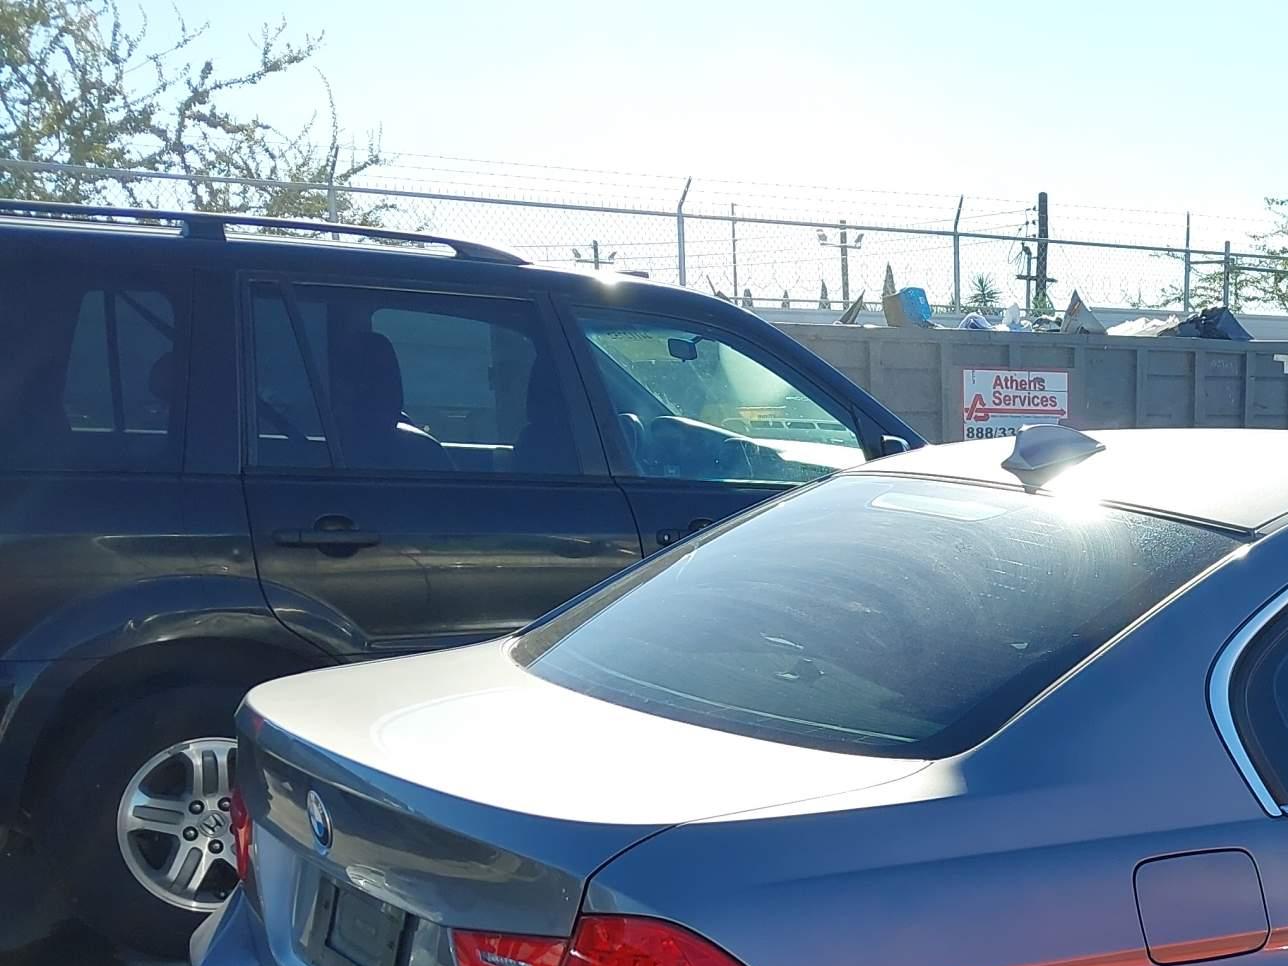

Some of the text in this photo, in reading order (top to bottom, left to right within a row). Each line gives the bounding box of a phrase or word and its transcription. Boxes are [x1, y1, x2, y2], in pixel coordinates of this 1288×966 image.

[992, 375, 1046, 391] Athens
[992, 390, 1058, 407] Services
[966, 426, 1019, 439] 888/33
